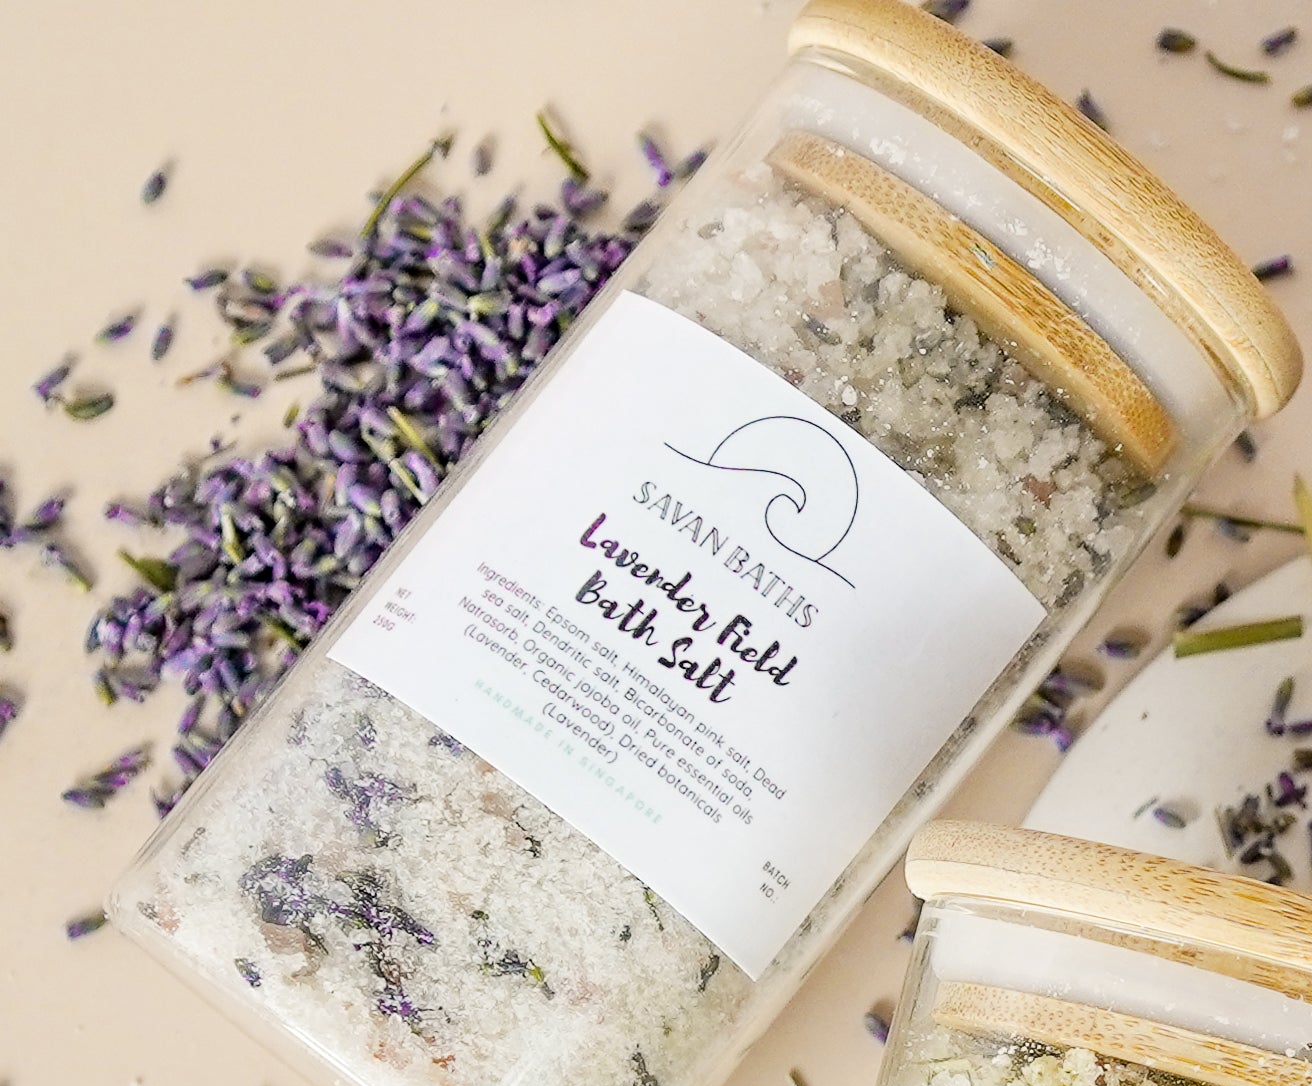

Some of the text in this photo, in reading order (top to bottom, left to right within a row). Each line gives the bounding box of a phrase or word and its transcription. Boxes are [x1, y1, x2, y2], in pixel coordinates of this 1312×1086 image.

[396, 587, 412, 600] NET
[578, 512, 799, 687] Lavender Field
[632, 480, 820, 629] SAVAN BATHS
[481, 589, 505, 608] sea
[531, 620, 593, 669] Dendritic
[623, 686, 705, 757] Bicarbonate
[705, 754, 724, 769] of
[545, 605, 591, 644] Epsom
[622, 661, 695, 724] Himalayan
[694, 721, 725, 749] pink
[752, 766, 787, 800] Dead
[574, 569, 736, 704] Bath Salt
[473, 678, 663, 825] HANDMADE IN SINGAPORE
[522, 638, 576, 682] Organic
[573, 680, 621, 716] jojoba
[643, 728, 676, 759] Pure
[676, 757, 734, 806] essential
[732, 804, 754, 825] oils
[541, 702, 619, 764] (Lavender)
[618, 733, 659, 769] Dried
[656, 763, 722, 824] botanicals
[762, 860, 791, 890] BATCH
